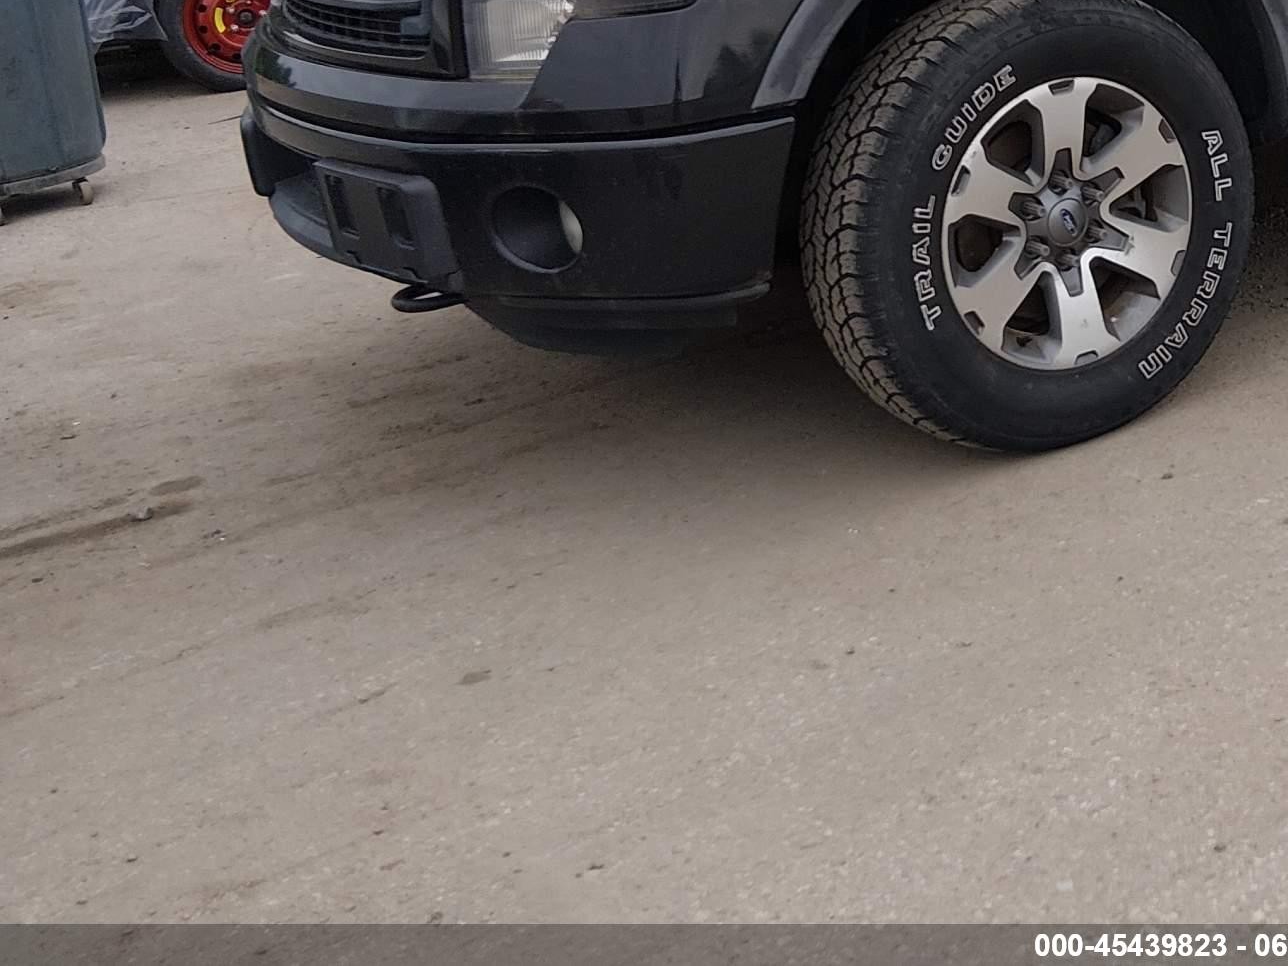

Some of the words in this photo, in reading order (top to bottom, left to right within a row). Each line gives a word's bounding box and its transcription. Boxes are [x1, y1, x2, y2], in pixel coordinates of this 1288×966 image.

[912, 194, 945, 331] TRAIL
[931, 64, 1017, 170] GUIDE
[1202, 129, 1234, 202] ALL
[1138, 222, 1233, 379] TERRAIN
